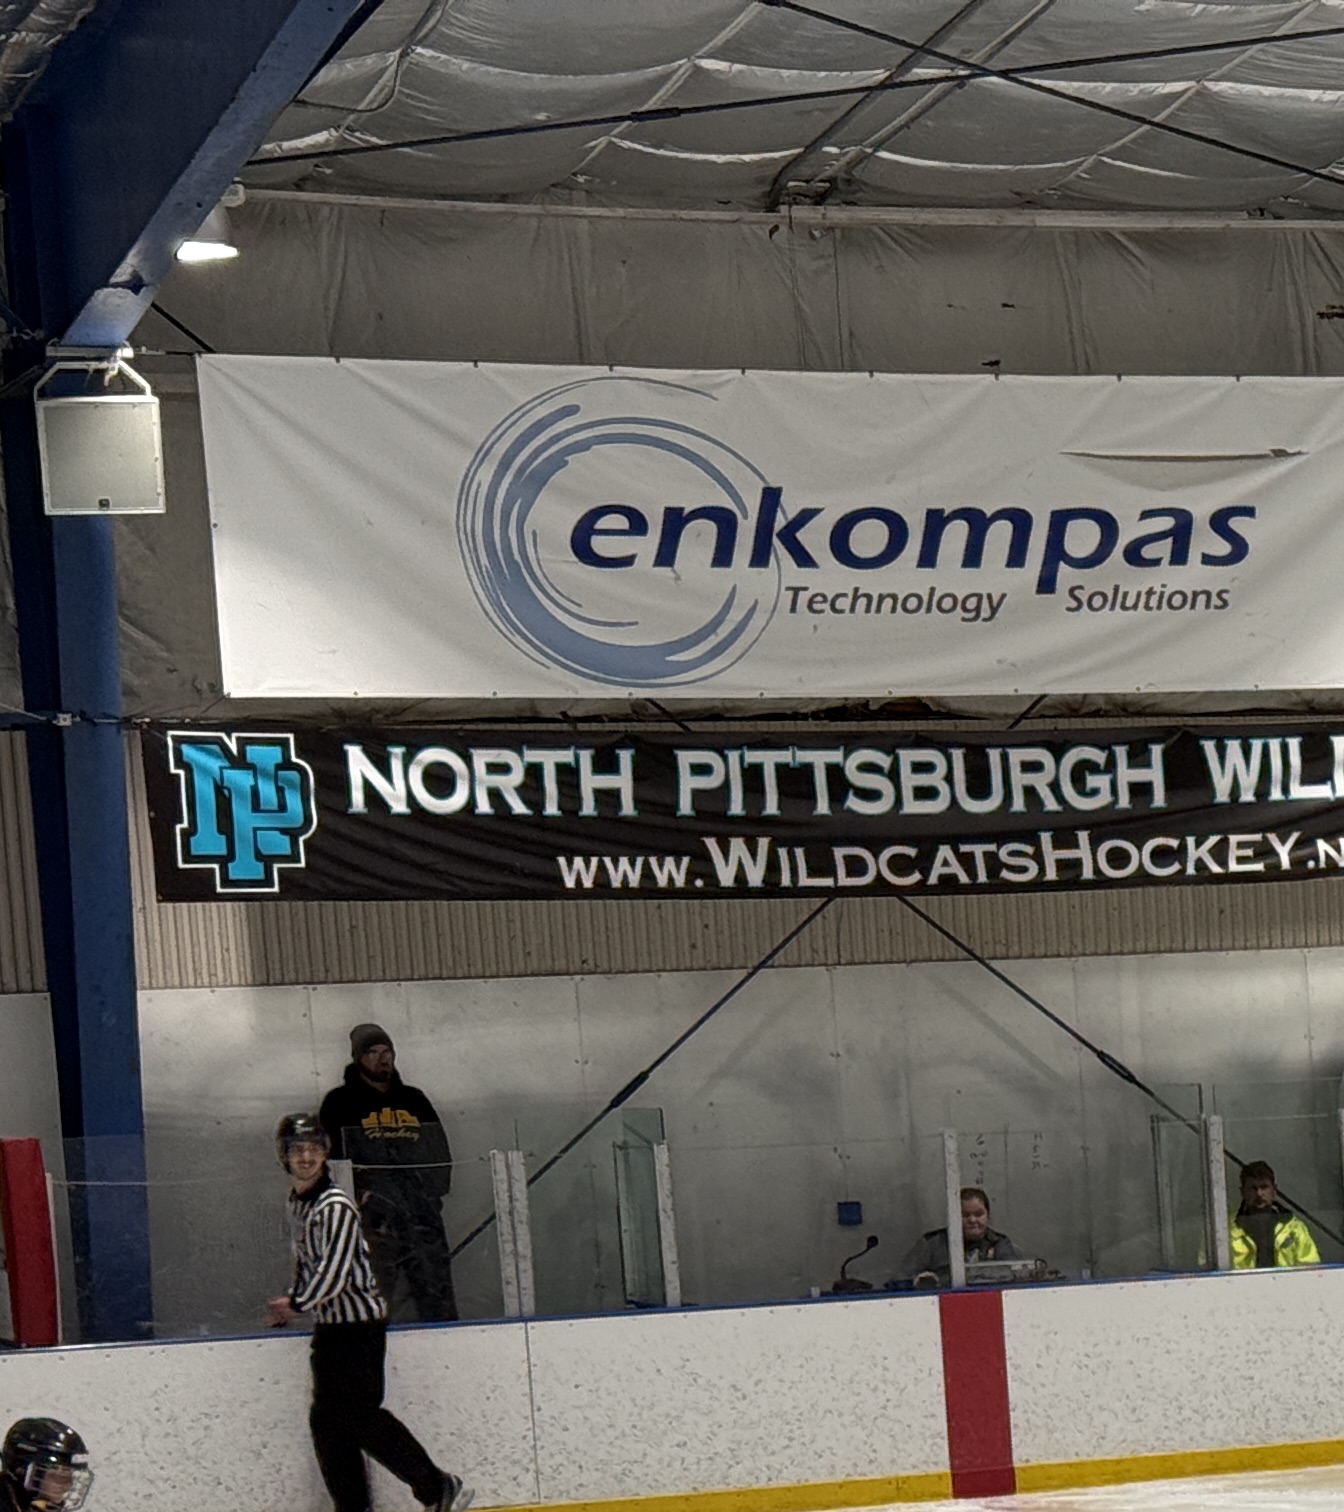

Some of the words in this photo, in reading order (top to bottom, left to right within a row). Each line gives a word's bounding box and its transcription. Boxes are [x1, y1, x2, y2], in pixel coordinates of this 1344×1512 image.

[569, 486, 1258, 596] enkompas
[785, 586, 1006, 623] Technology
[1065, 583, 1231, 614] Solutions
[343, 743, 639, 817] NORTH
[672, 742, 1166, 818] PITTSBURGH
